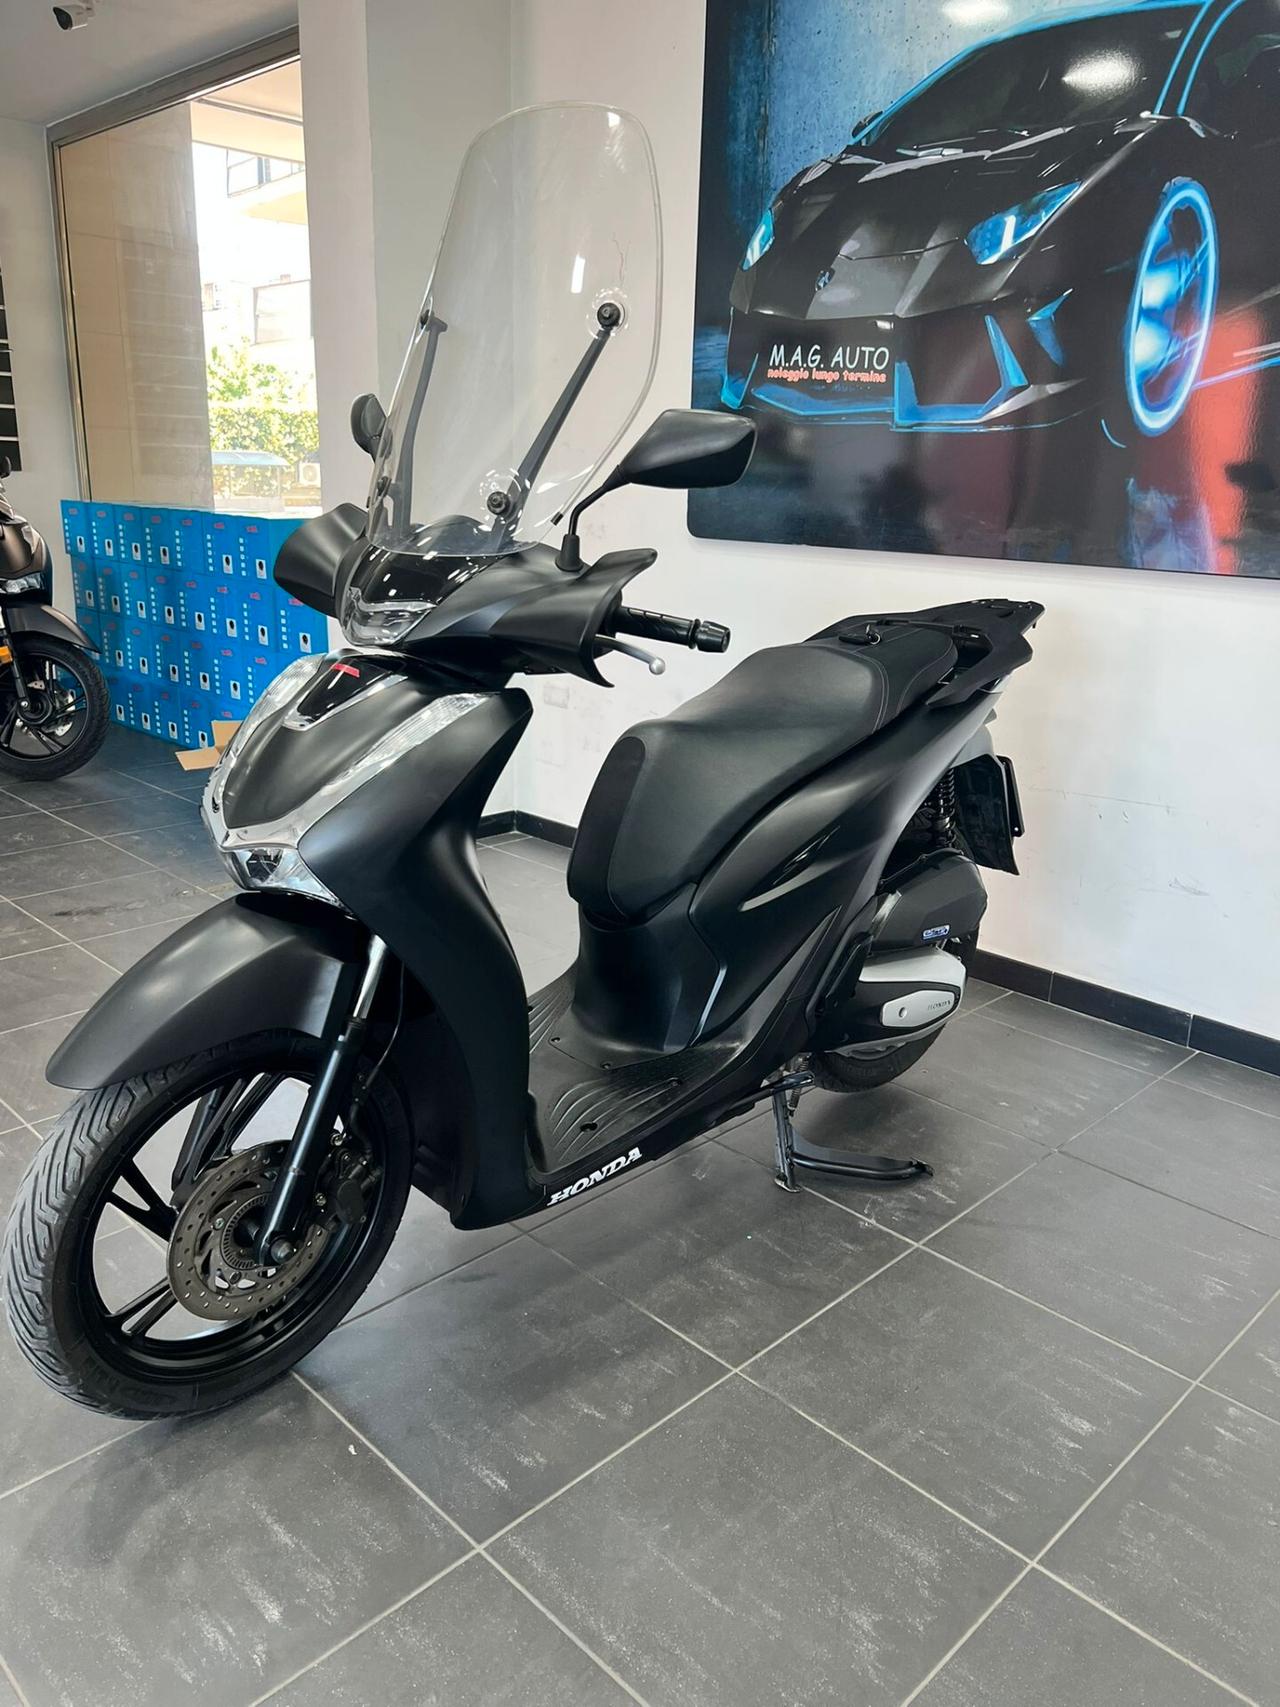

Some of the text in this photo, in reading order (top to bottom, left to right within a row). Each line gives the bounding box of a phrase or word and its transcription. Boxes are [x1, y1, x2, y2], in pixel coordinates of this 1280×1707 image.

[769, 344, 890, 370] M.A.G. AUTO
[811, 367, 840, 383] lungo
[843, 370, 887, 383] termine
[546, 1146, 643, 1206] HONDA
